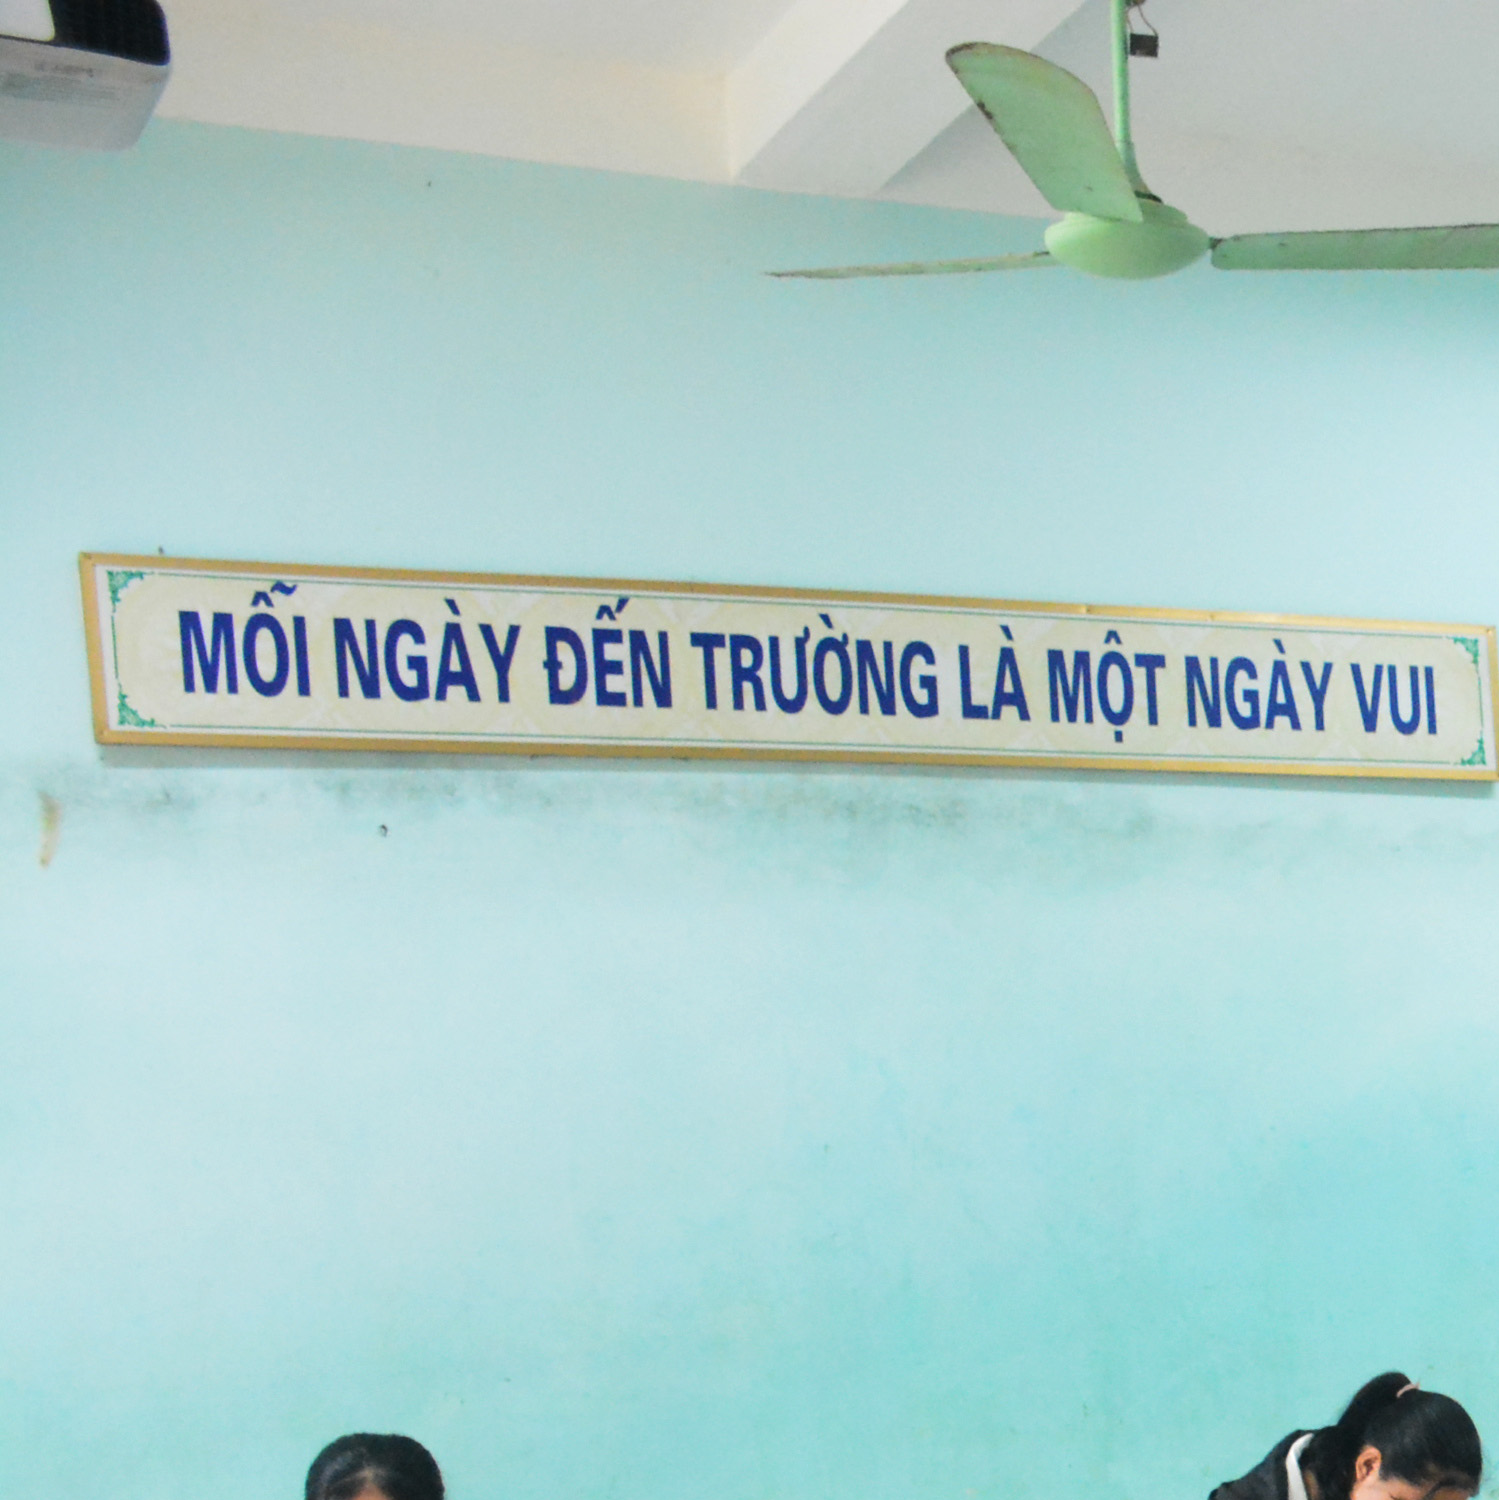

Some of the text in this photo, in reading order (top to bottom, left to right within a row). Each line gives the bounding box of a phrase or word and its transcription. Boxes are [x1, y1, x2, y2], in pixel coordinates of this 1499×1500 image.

[178, 579, 1437, 743] MỖI NGÀY ĐẾN TRƯỜNG LÀ MỘT NGÀY VUI
